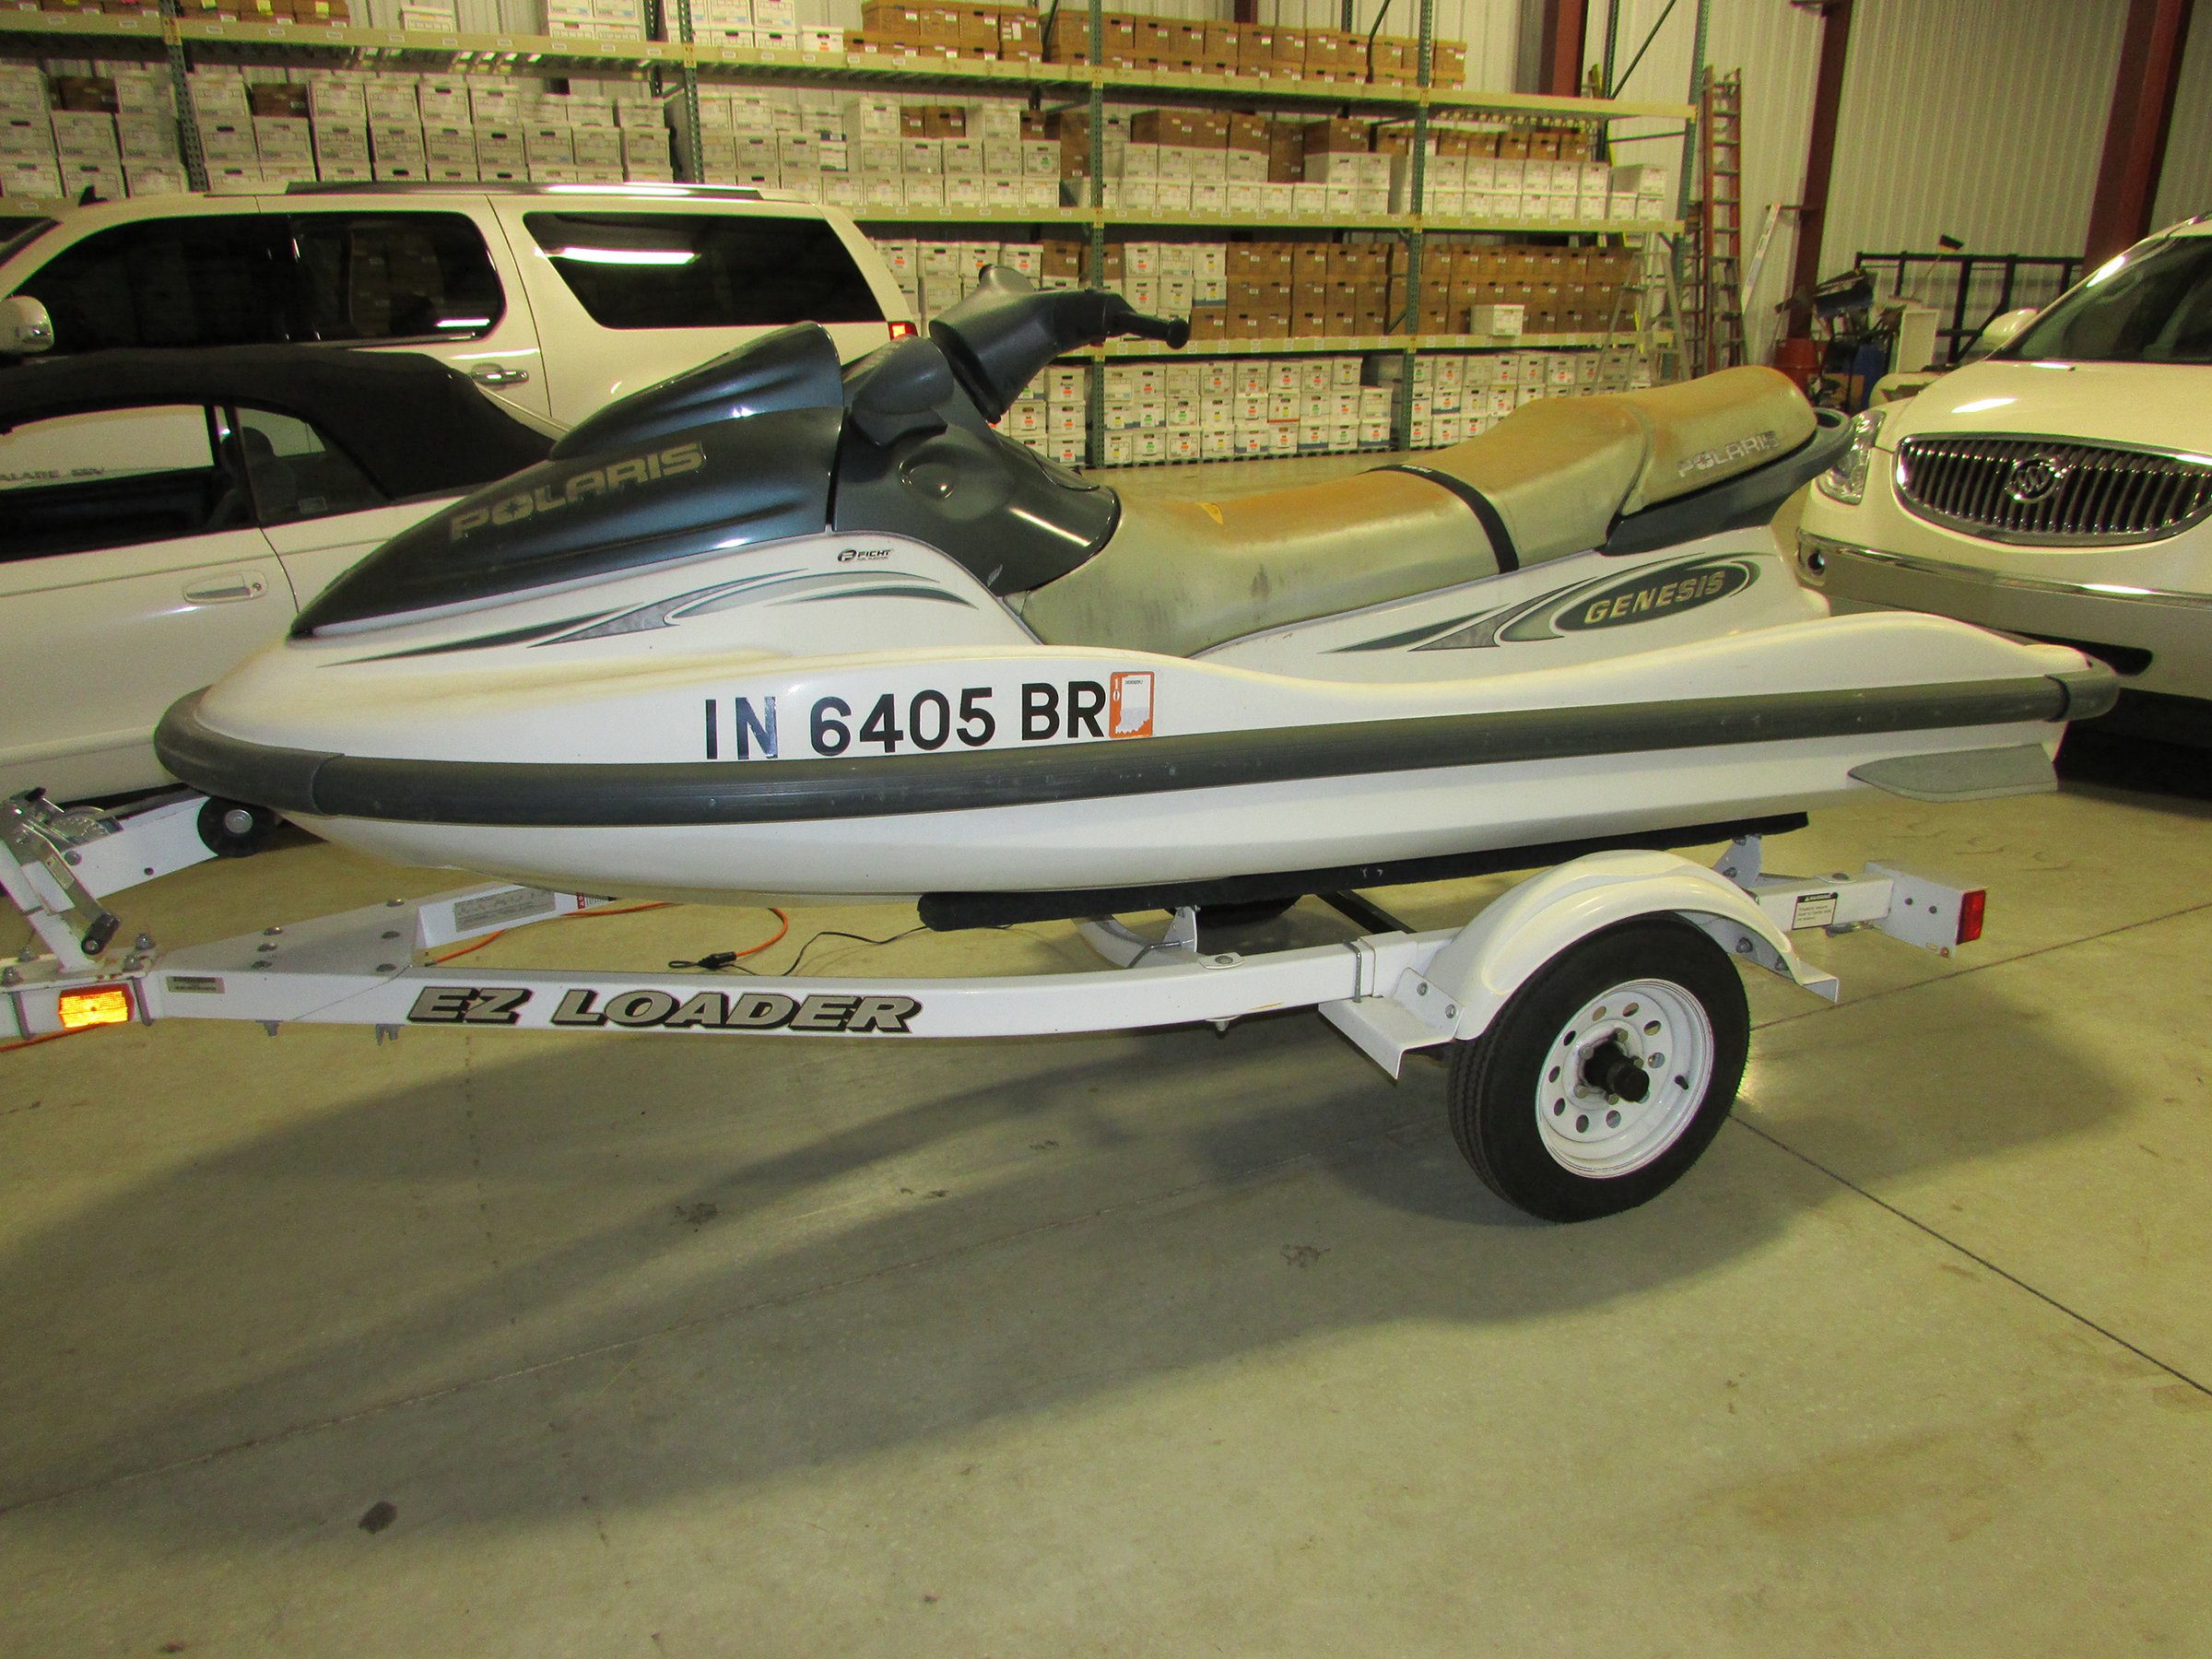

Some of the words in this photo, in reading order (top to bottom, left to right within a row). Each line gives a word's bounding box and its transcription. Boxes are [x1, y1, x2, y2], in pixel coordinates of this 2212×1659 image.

[451, 441, 705, 541] POLARIS
[1584, 570, 1726, 624] GENESIS
[706, 696, 778, 760] IN
[810, 687, 996, 757] 6405
[1021, 680, 1107, 741] BR
[407, 986, 532, 1024] EZ
[553, 989, 924, 1033] LOADER
